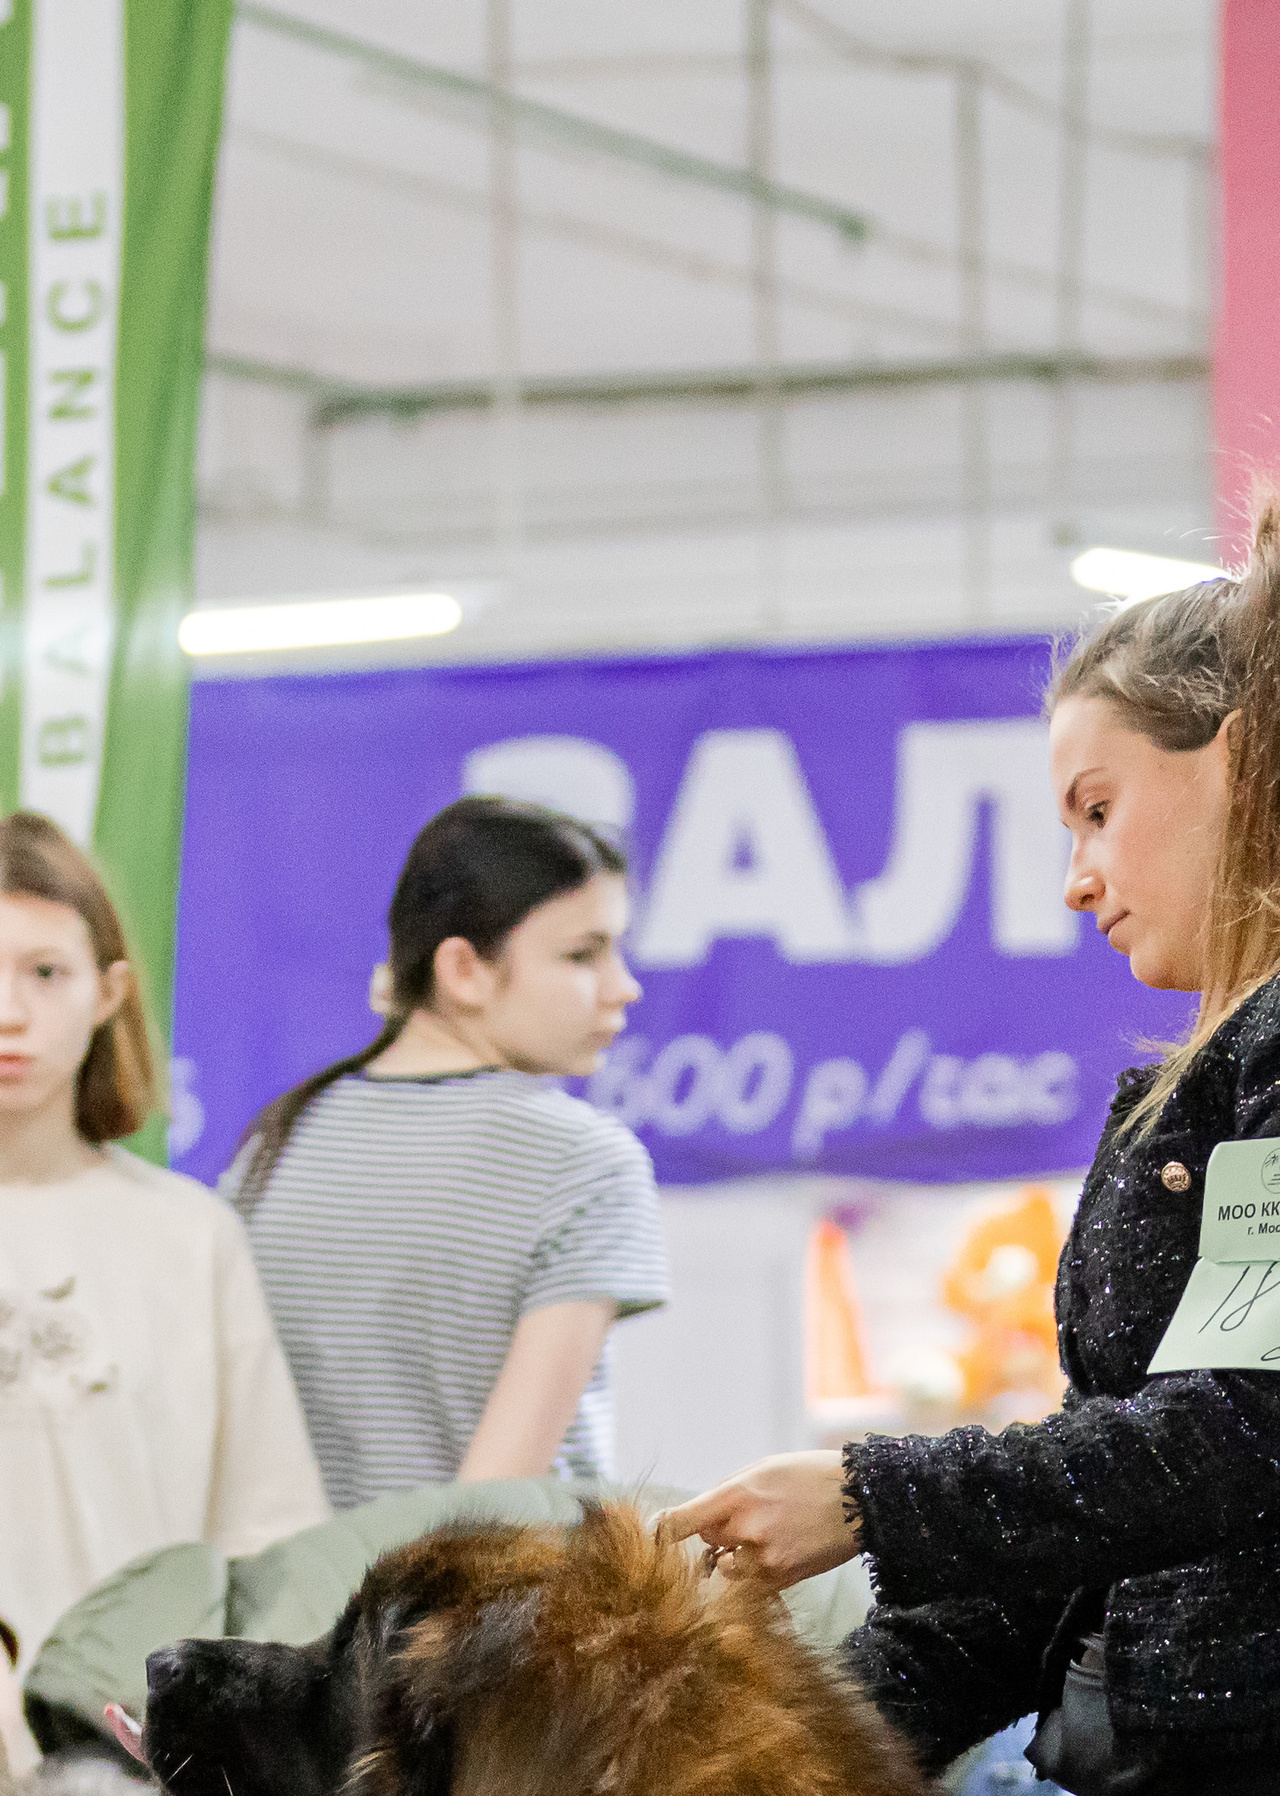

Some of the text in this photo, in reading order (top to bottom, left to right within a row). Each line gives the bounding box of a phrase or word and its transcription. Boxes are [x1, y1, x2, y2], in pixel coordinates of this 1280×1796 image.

[38, 188, 108, 770] BALANCE
[793, 1027, 1080, 1163] р/час
[1218, 1203, 1256, 1221] МОО
[1261, 1201, 1280, 1217] КК
[1247, 1226, 1254, 1236] г.
